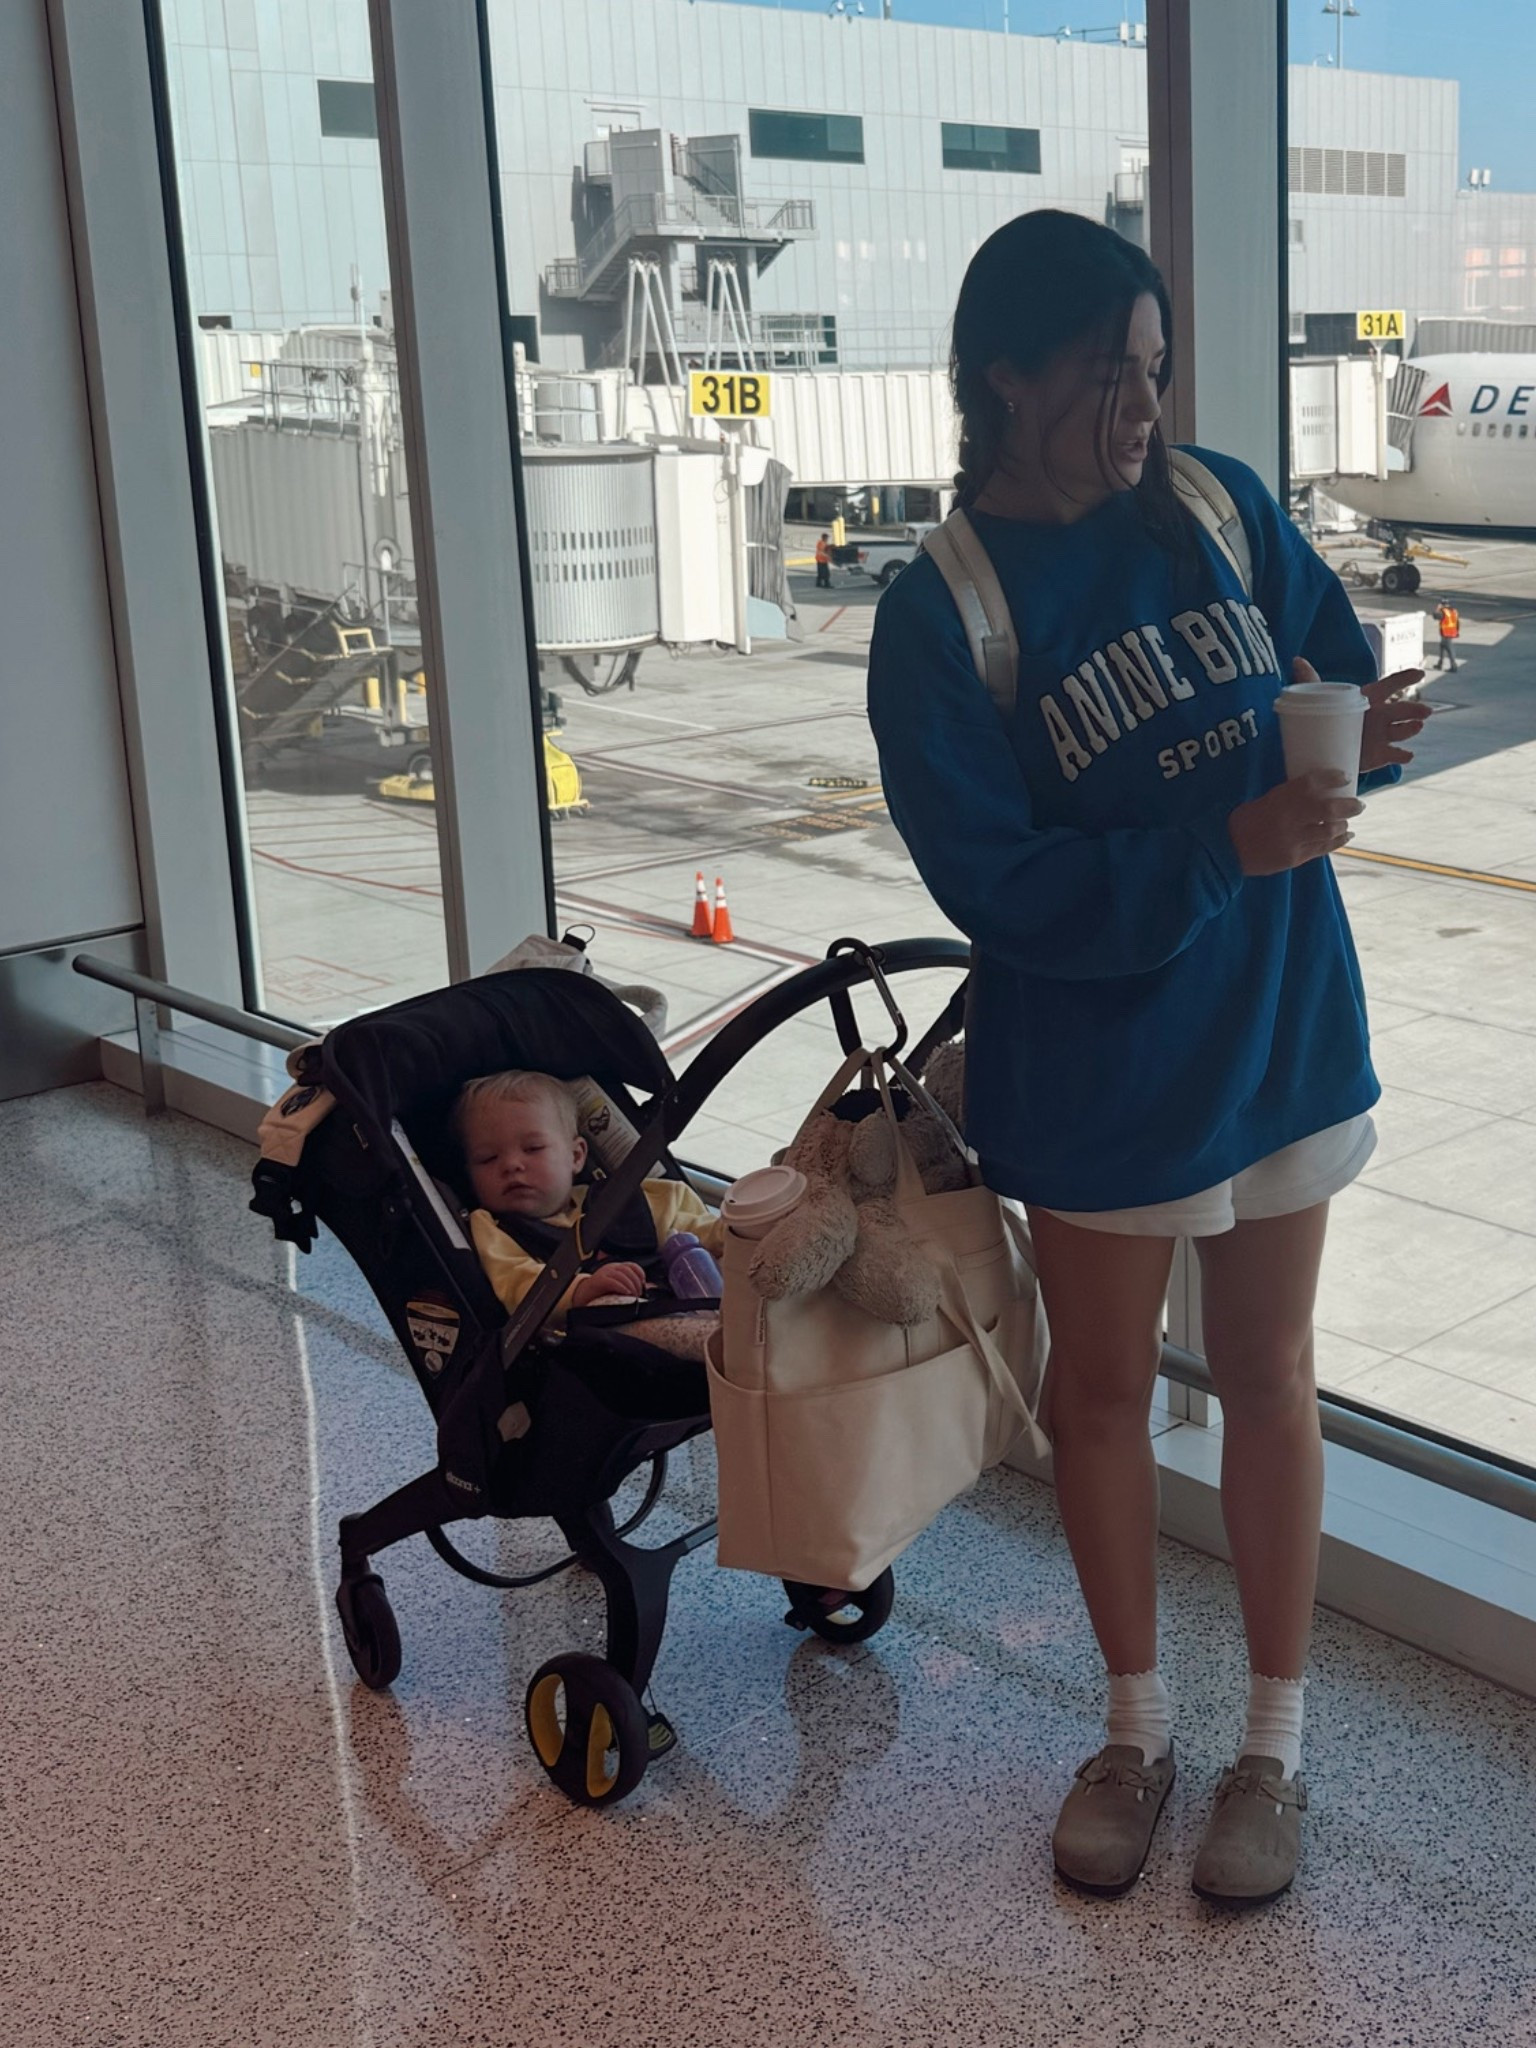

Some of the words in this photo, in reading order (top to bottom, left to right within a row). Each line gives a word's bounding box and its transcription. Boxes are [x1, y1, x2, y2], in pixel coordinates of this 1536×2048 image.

[1363, 313, 1399, 336] 31A
[702, 376, 761, 414] 31B
[1470, 385, 1536, 415] DE
[1040, 624, 1196, 782] ANINE
[1158, 708, 1258, 779] SPORT
